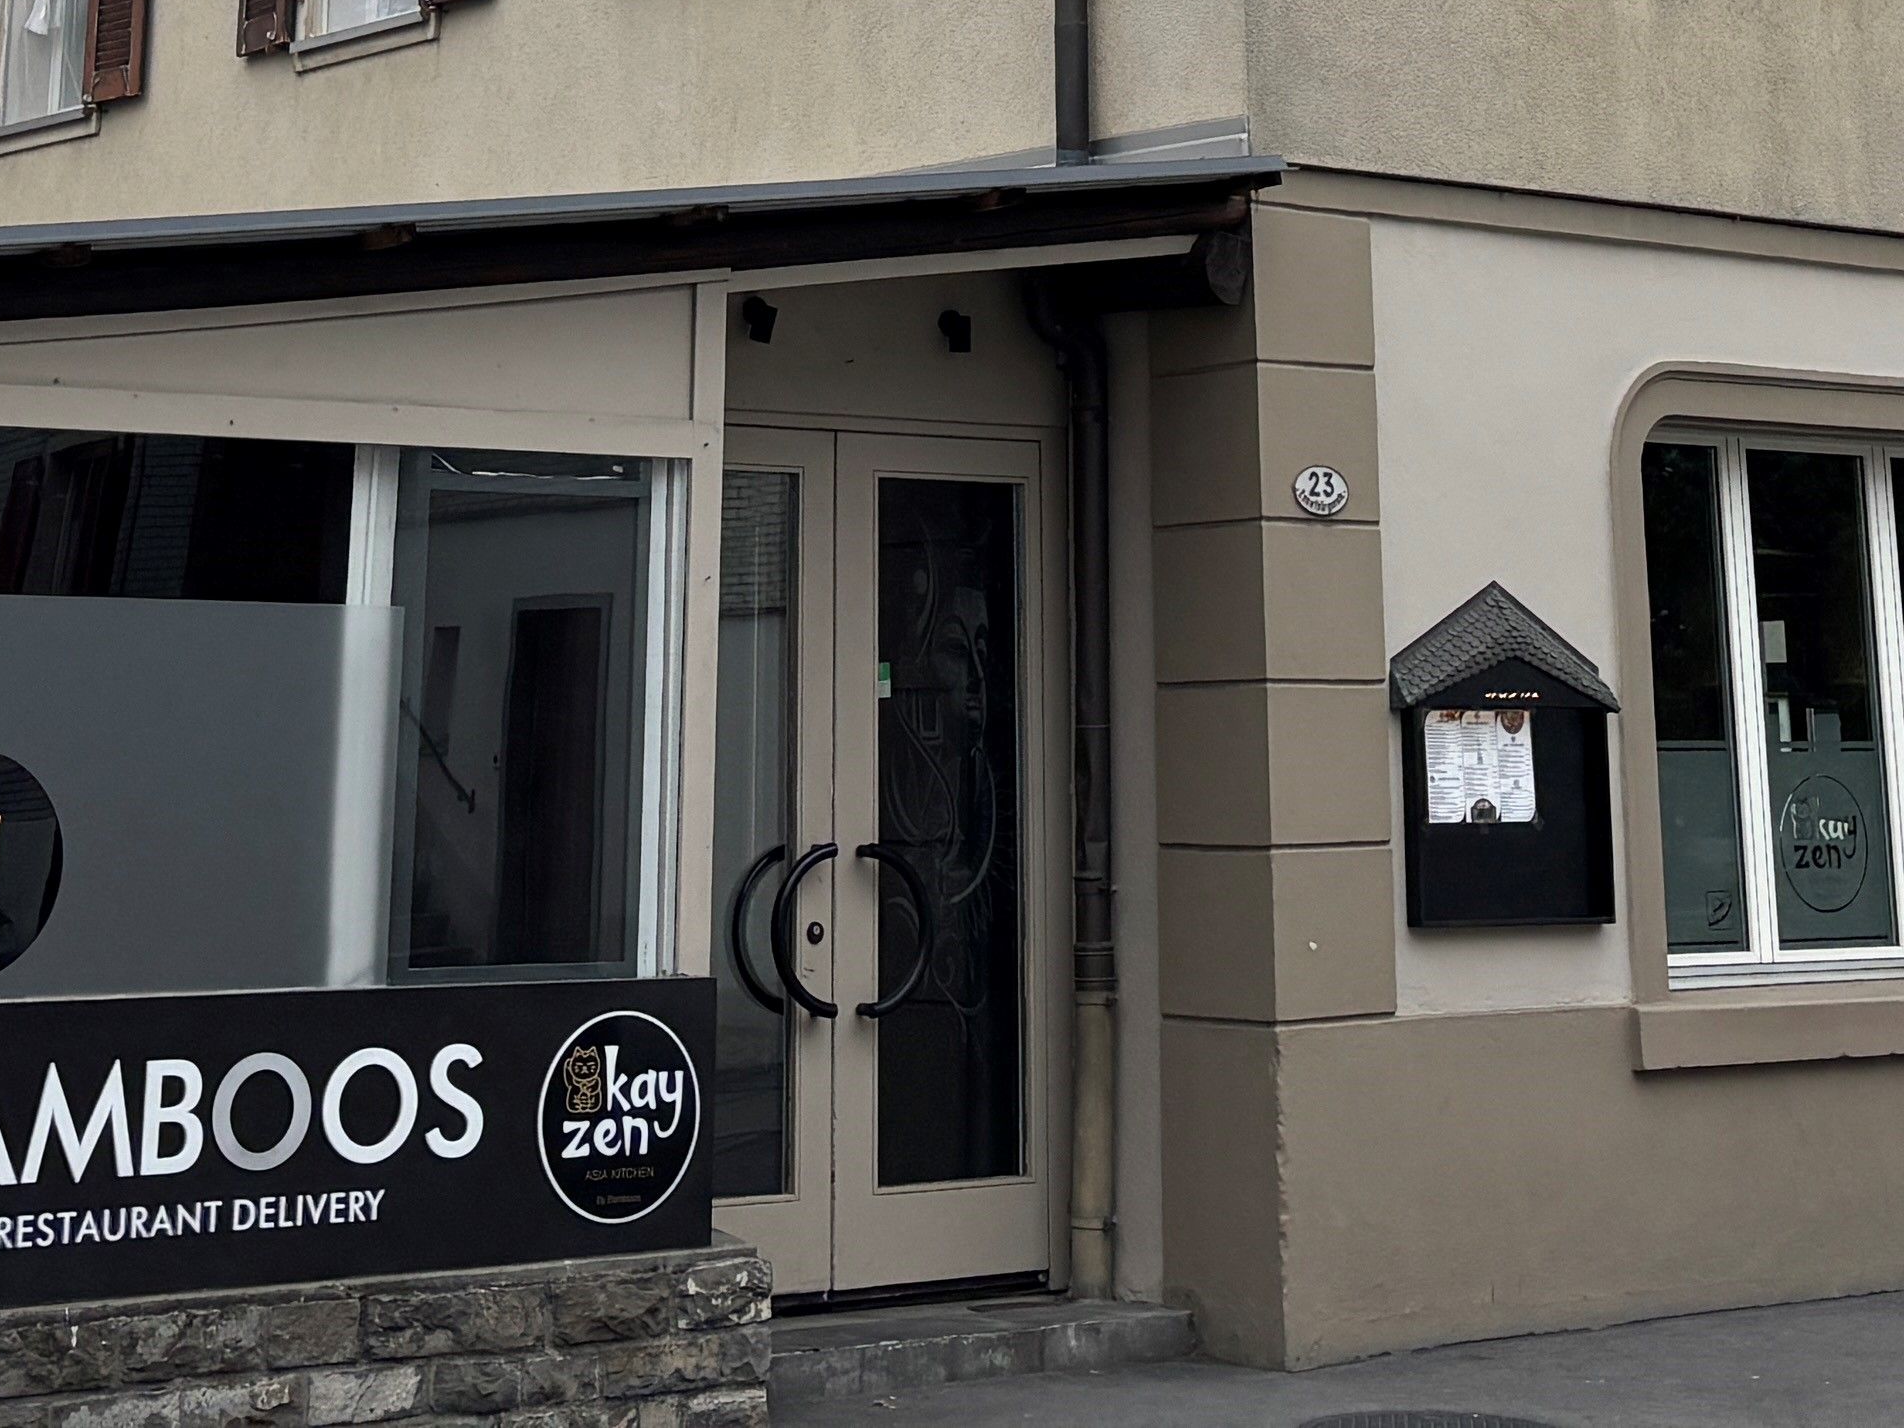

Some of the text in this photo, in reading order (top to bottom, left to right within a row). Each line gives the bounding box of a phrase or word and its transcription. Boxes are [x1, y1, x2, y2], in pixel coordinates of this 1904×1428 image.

[1308, 471, 1335, 497] 23
[1794, 844, 1842, 869] zen
[604, 1045, 684, 1139] kay
[561, 1115, 649, 1159] zen
[610, 1166, 655, 1178] KITCHEN
[232, 1189, 385, 1231] DELIVERY
